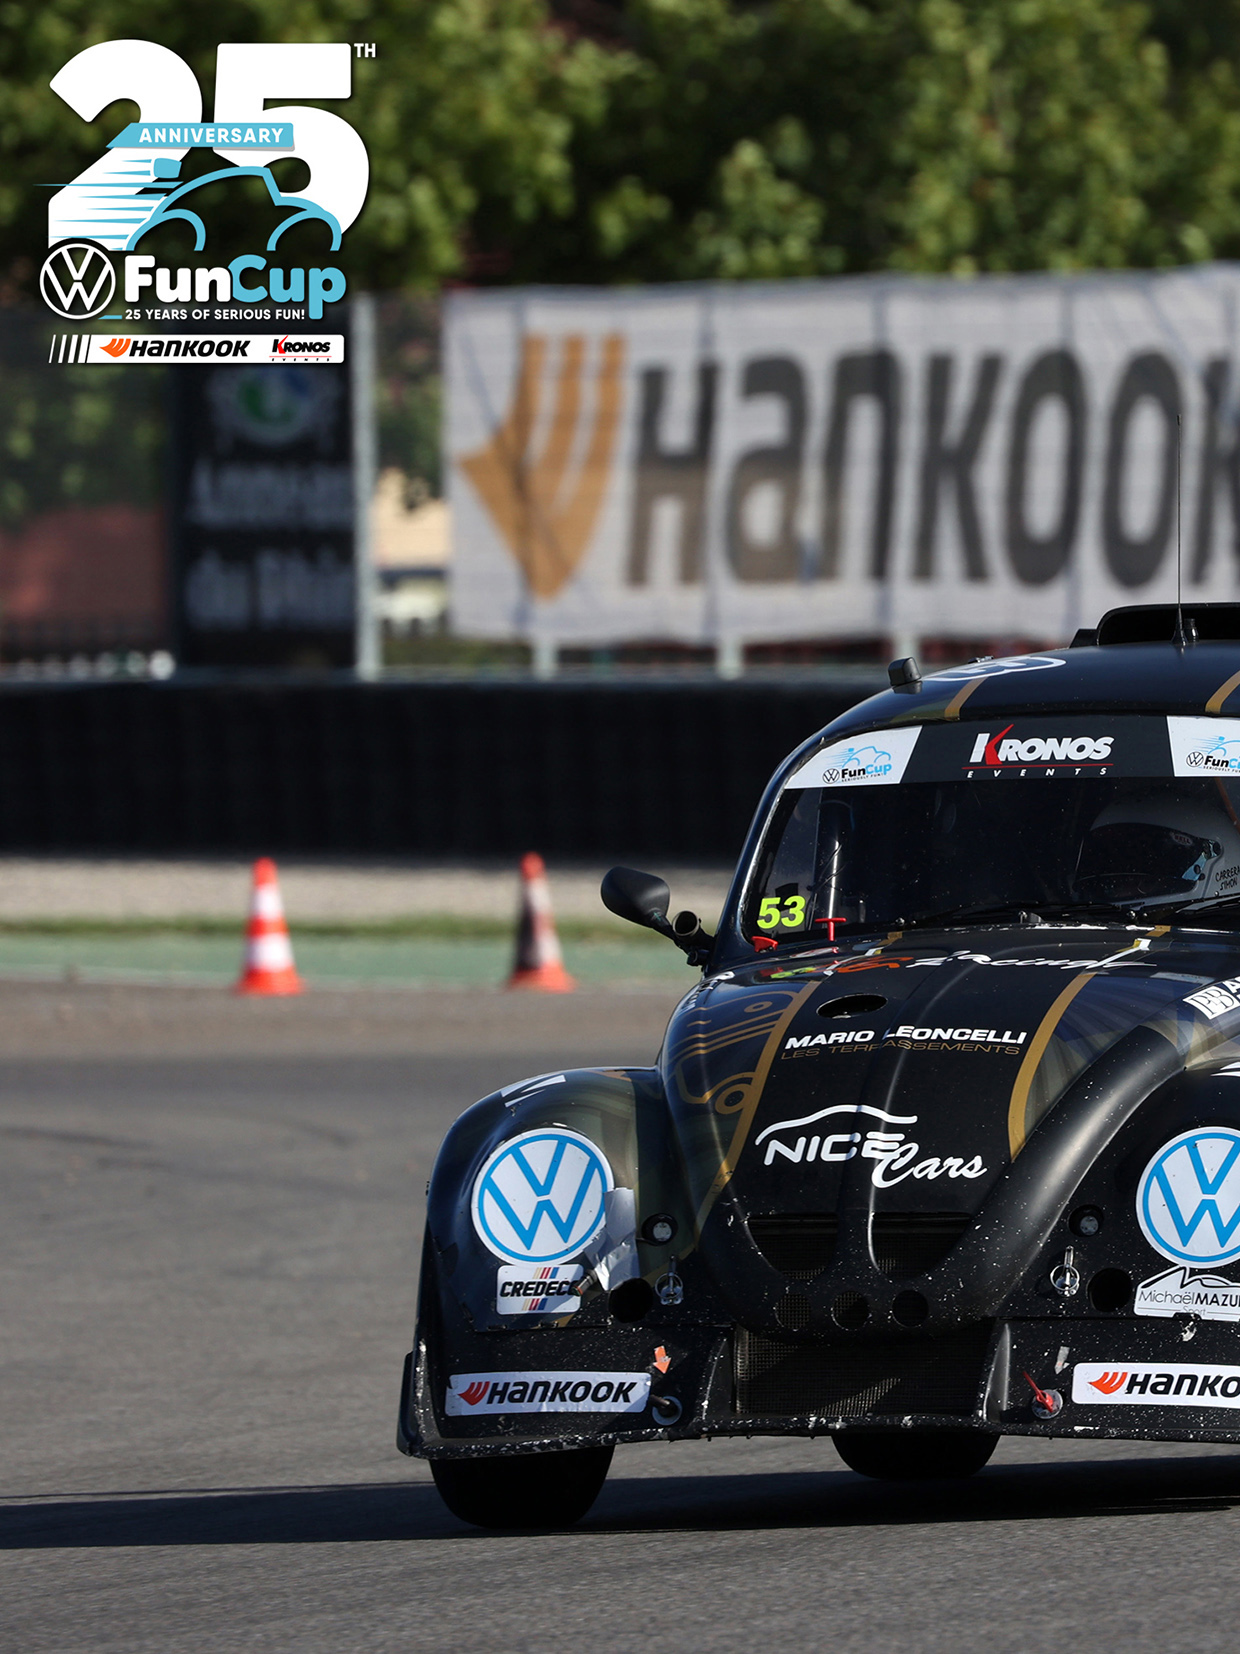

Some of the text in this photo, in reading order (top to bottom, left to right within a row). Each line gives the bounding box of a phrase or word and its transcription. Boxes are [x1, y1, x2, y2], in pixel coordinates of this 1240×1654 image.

[969, 723, 1115, 765] KRONOS
[841, 763, 892, 779] FunCup
[967, 767, 1107, 778] EVENTS
[757, 895, 805, 927] 53
[785, 1026, 1027, 1049] MARIO LEONCELLI
[781, 1048, 819, 1060] LES
[763, 1131, 905, 1166] NICE
[871, 1141, 987, 1189] Cars
